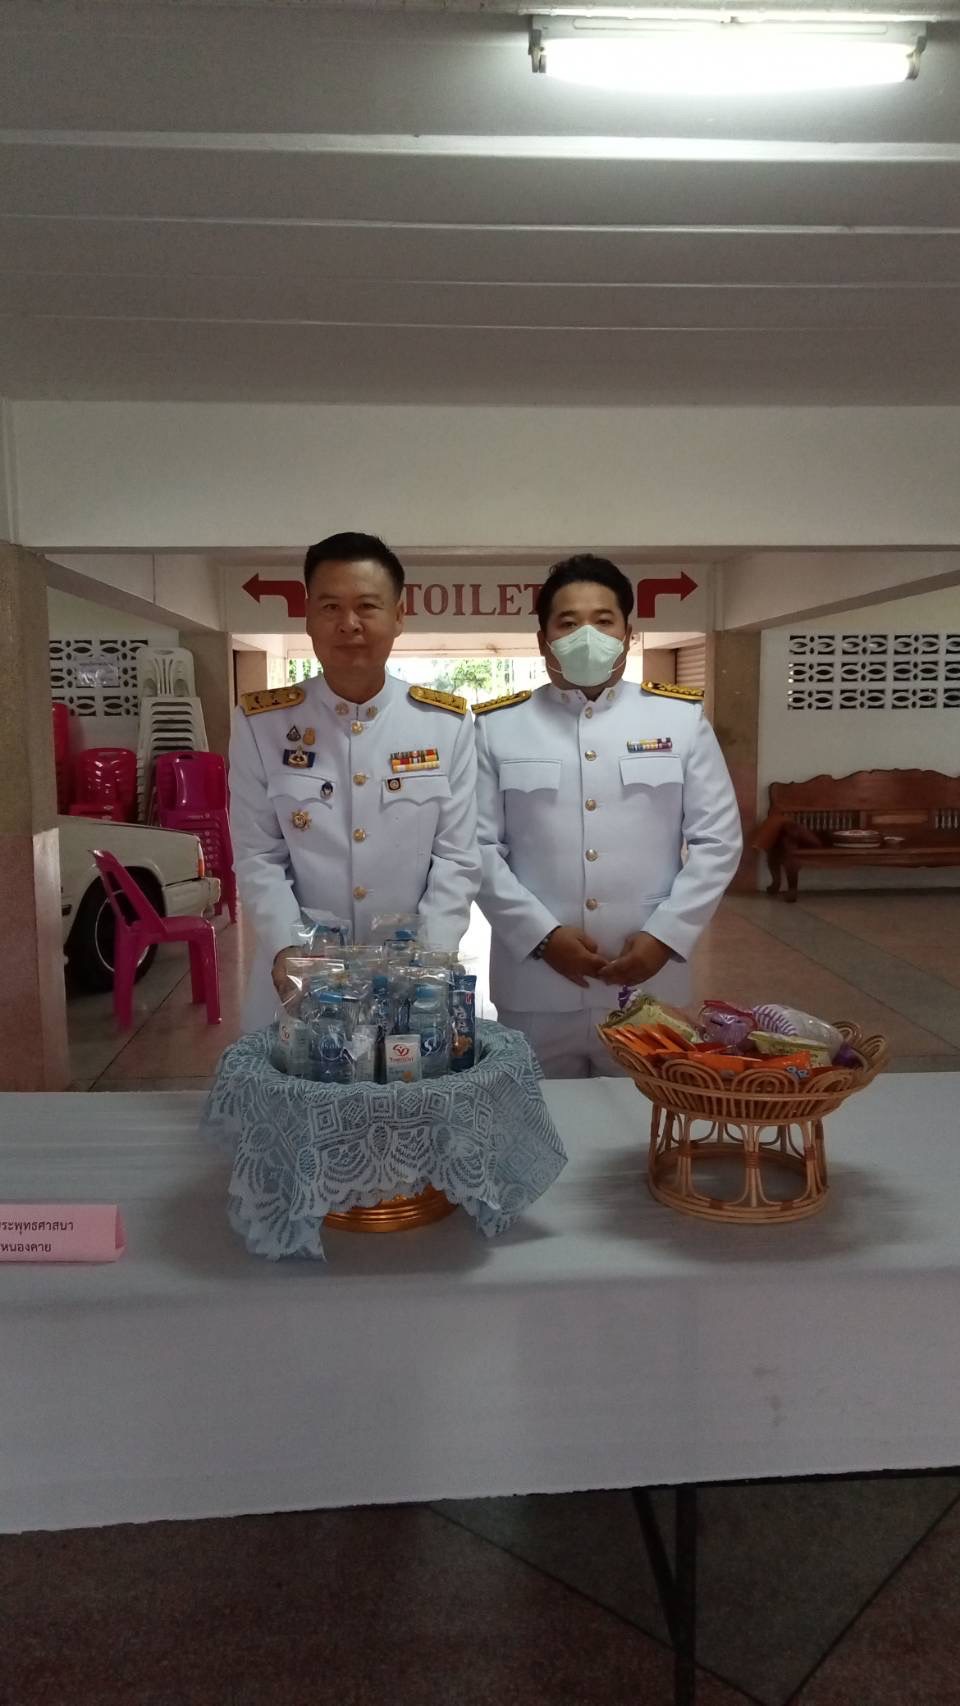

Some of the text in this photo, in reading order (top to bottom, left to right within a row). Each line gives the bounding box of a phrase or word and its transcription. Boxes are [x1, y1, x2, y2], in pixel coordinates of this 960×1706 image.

[403, 583, 543, 616] TOILET
[0, 1221, 74, 1235] ระพุทธศาสนา
